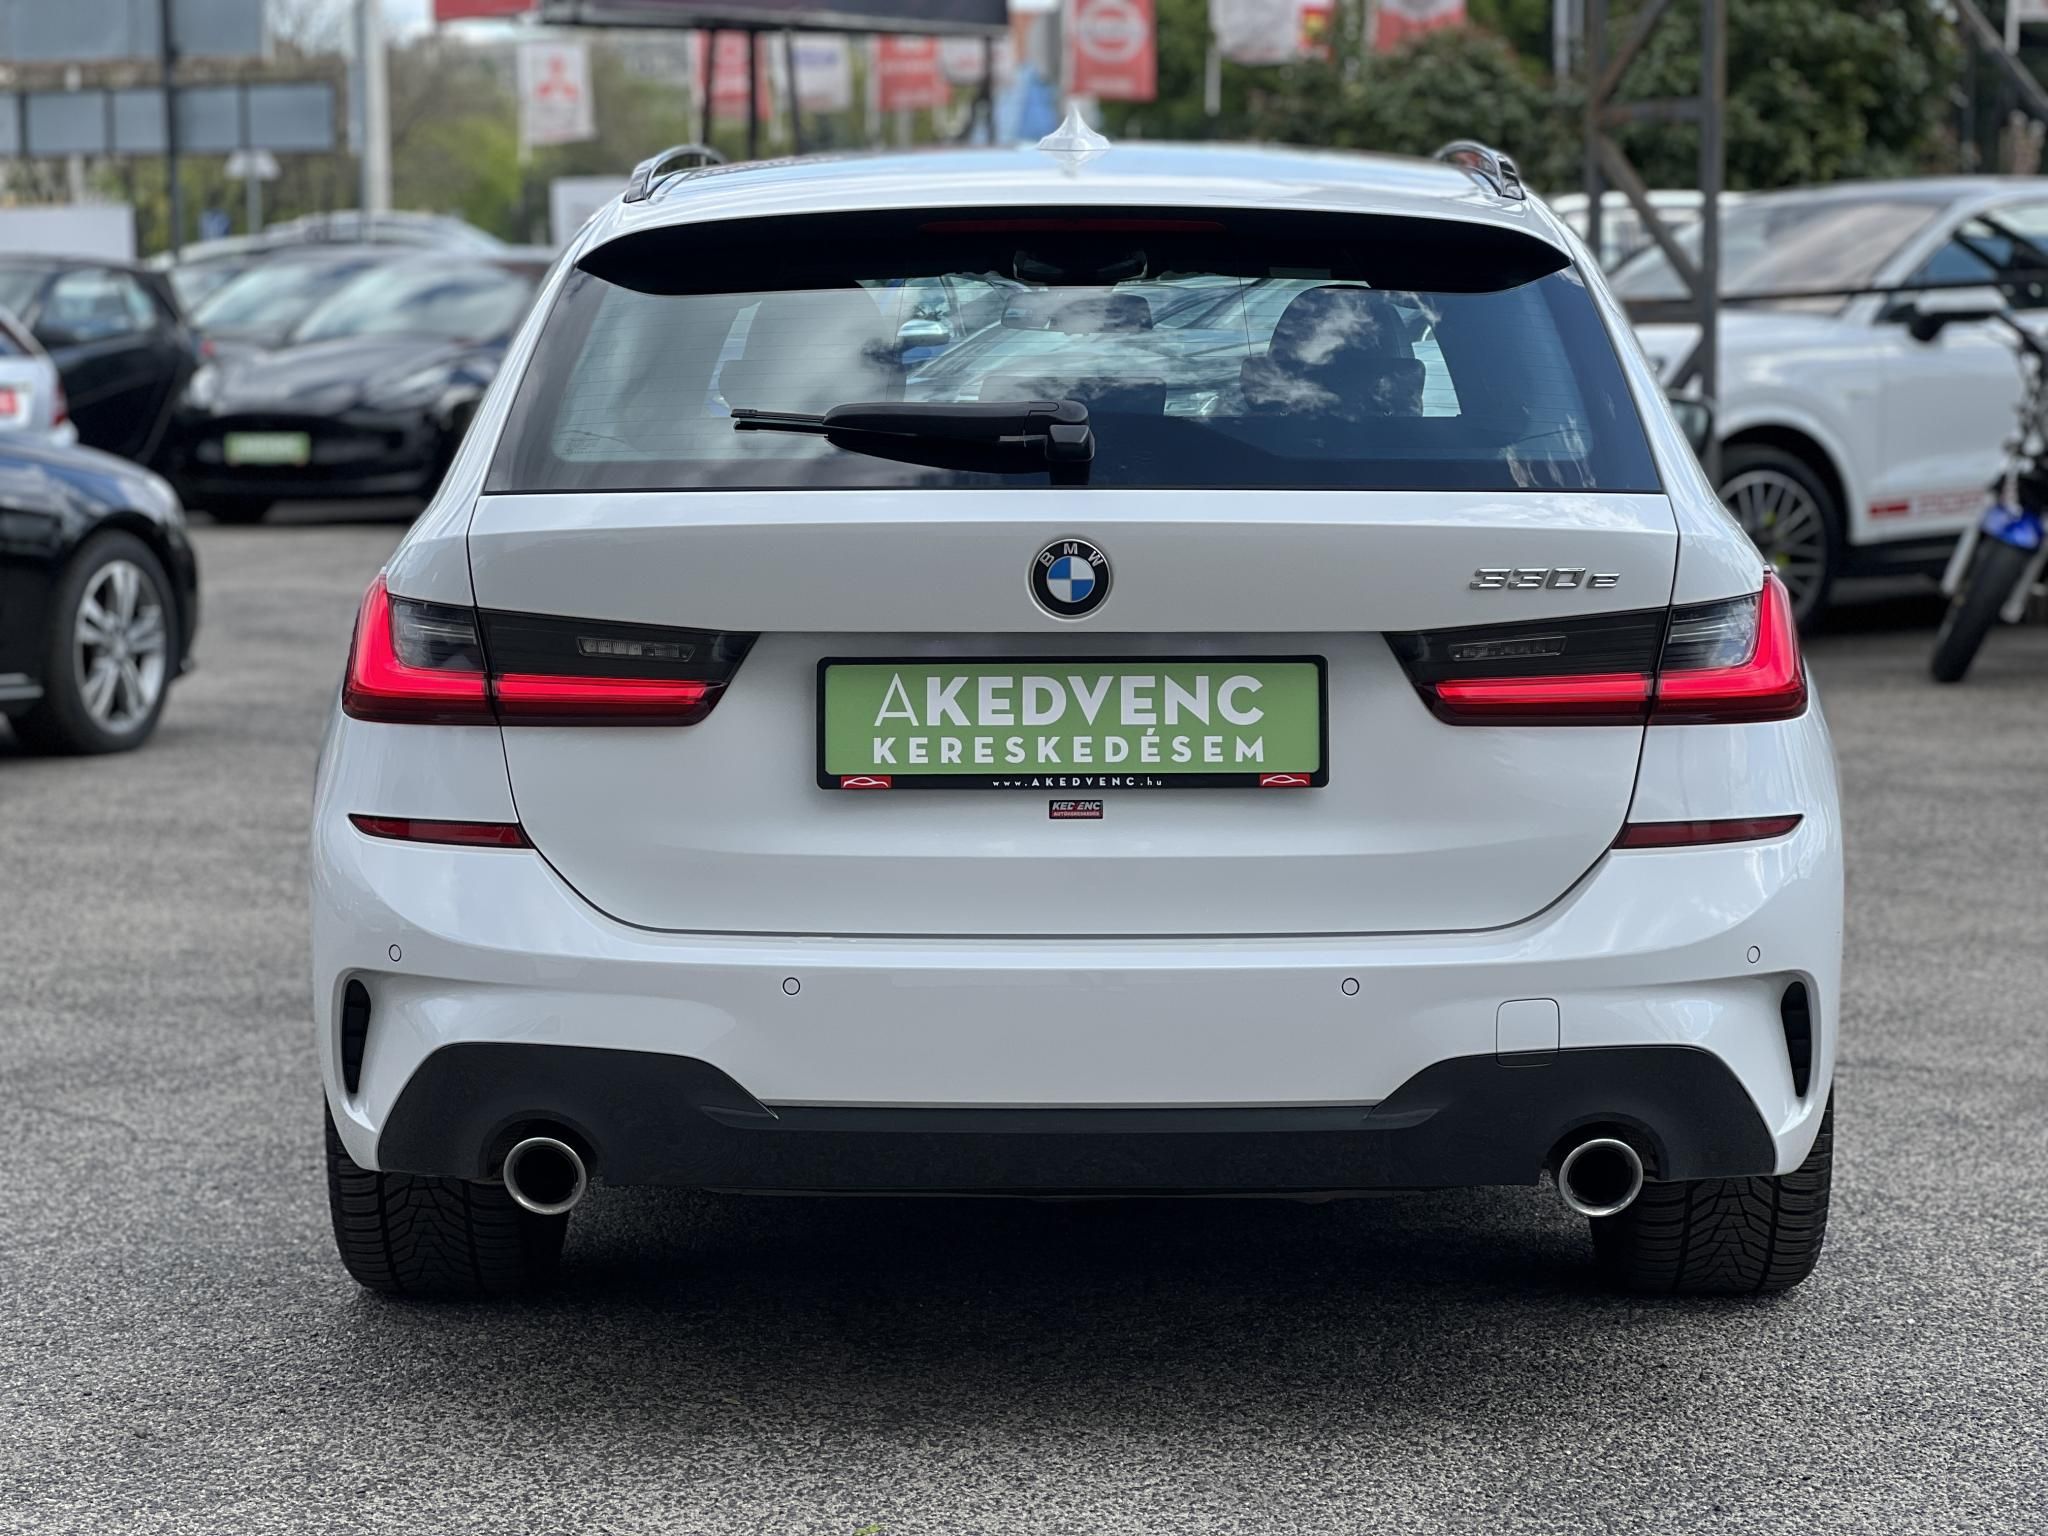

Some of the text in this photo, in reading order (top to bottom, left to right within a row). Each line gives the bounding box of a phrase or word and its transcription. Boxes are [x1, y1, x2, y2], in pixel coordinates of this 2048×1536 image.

[1040, 543, 1104, 567] BMW
[873, 673, 1265, 727] AKEDVENC
[873, 729, 1265, 764] KERESKEDÉSEM
[992, 776, 1163, 787] www.AKEDVENC.hu
[1052, 801, 1101, 811] KEDENC
